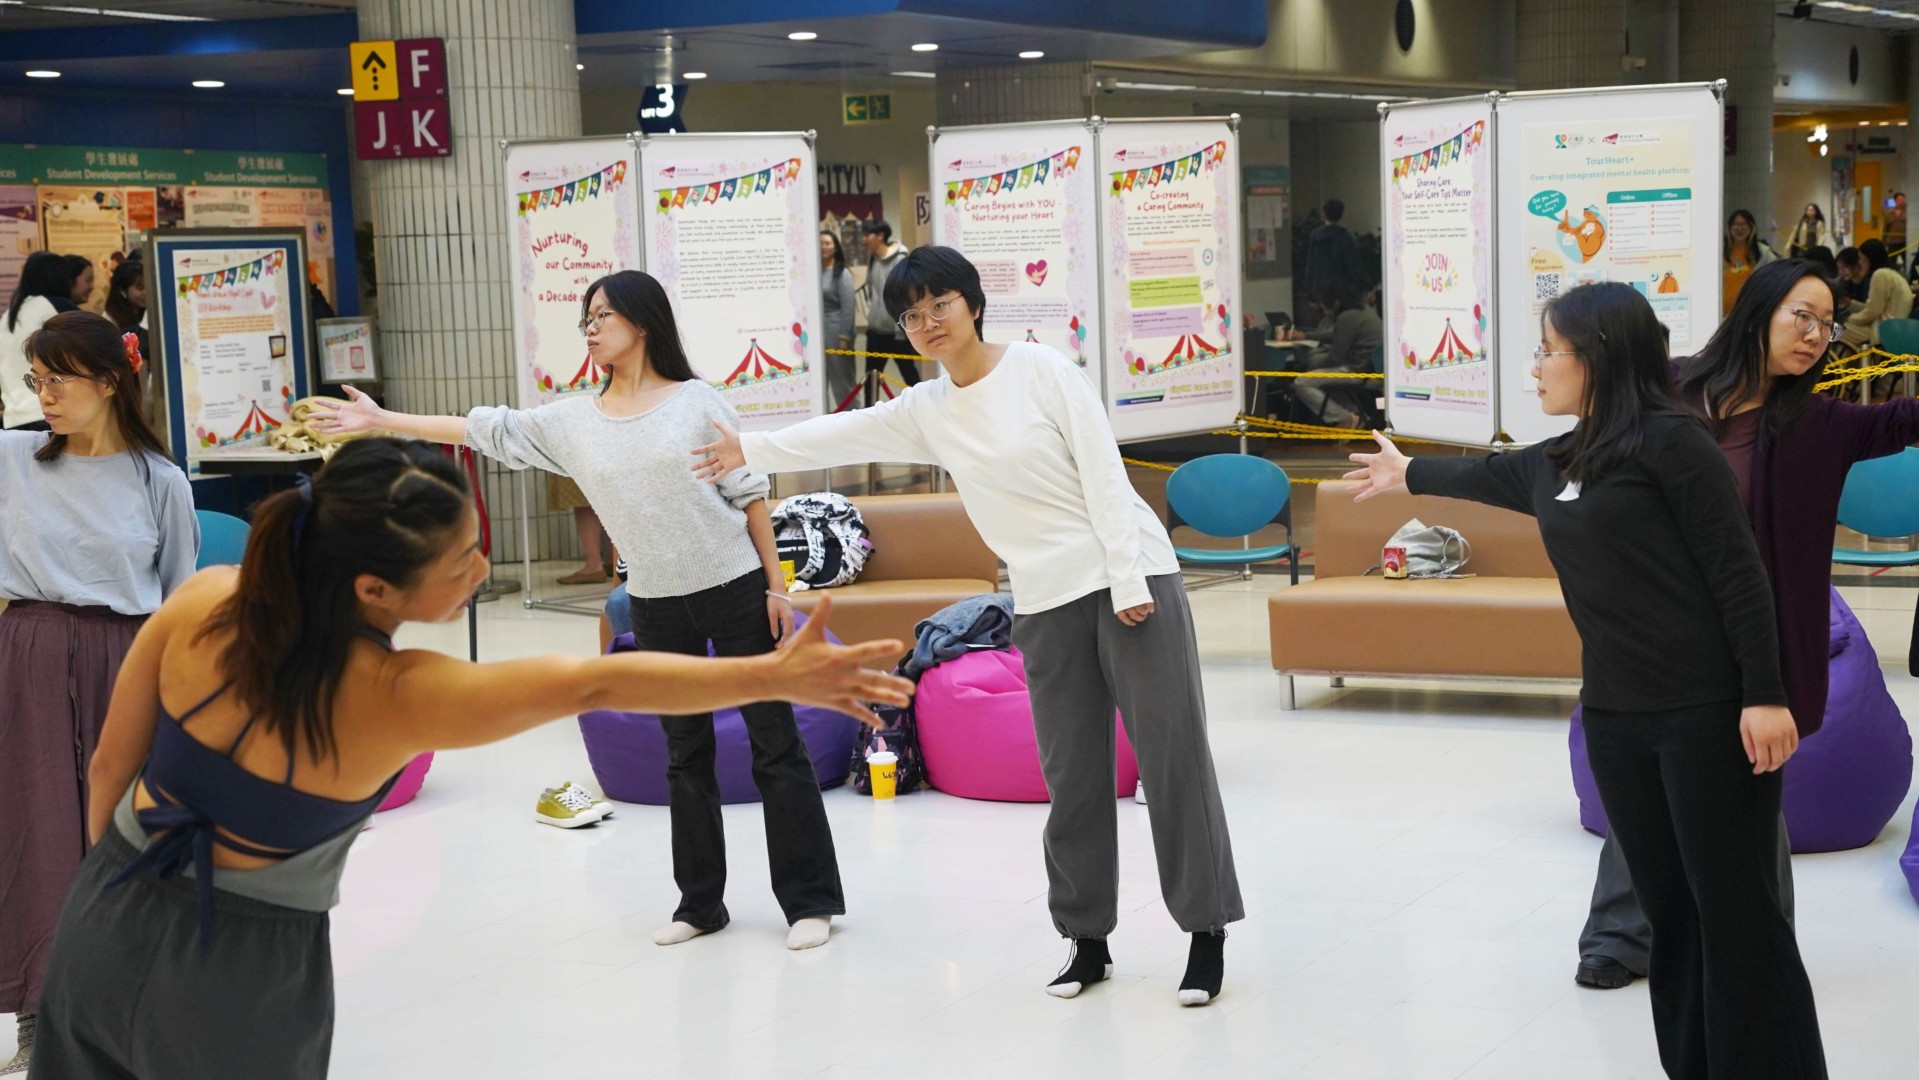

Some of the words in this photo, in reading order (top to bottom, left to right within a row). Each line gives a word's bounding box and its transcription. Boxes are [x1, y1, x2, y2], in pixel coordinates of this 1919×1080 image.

[410, 49, 429, 88] F
[656, 84, 675, 117] 3
[373, 111, 387, 150] J
[412, 109, 439, 147] K
[1585, 157, 1635, 166] TourHeart+
[46, 168, 82, 180] Student
[84, 169, 141, 182] Development
[143, 169, 177, 181] Services
[204, 172, 236, 183] Student
[236, 173, 287, 185] Development
[288, 174, 318, 184] Services
[1530, 172, 1565, 182] One-stop
[1566, 170, 1605, 181] integrated
[1606, 169, 1631, 178] mental
[1633, 168, 1657, 177] health
[1658, 166, 1690, 176] platform
[1417, 178, 1437, 189] Sharing
[1150, 190, 1189, 200] Co-creating
[1402, 191, 1413, 200] Your
[1414, 188, 1440, 200] Self-Care
[1440, 188, 1451, 200] Tips
[1452, 187, 1472, 198] Matter
[964, 201, 989, 212] Caring
[991, 200, 1016, 211] Begins
[1018, 200, 1035, 209] with
[1037, 199, 1055, 208] YOU
[1143, 202, 1166, 212] Caring
[1167, 201, 1204, 211] Community
[971, 213, 1010, 223] Nurturing
[1011, 213, 1029, 223] your
[1031, 211, 1054, 220] Heart
[531, 230, 589, 258] Nurturing
[545, 261, 559, 270] our
[562, 257, 613, 274] Community
[1425, 252, 1448, 272] JOIN
[1531, 257, 1547, 265] Free
[574, 275, 589, 285] with
[1431, 276, 1443, 293] US
[538, 293, 544, 301] a
[546, 290, 577, 302] Decade
